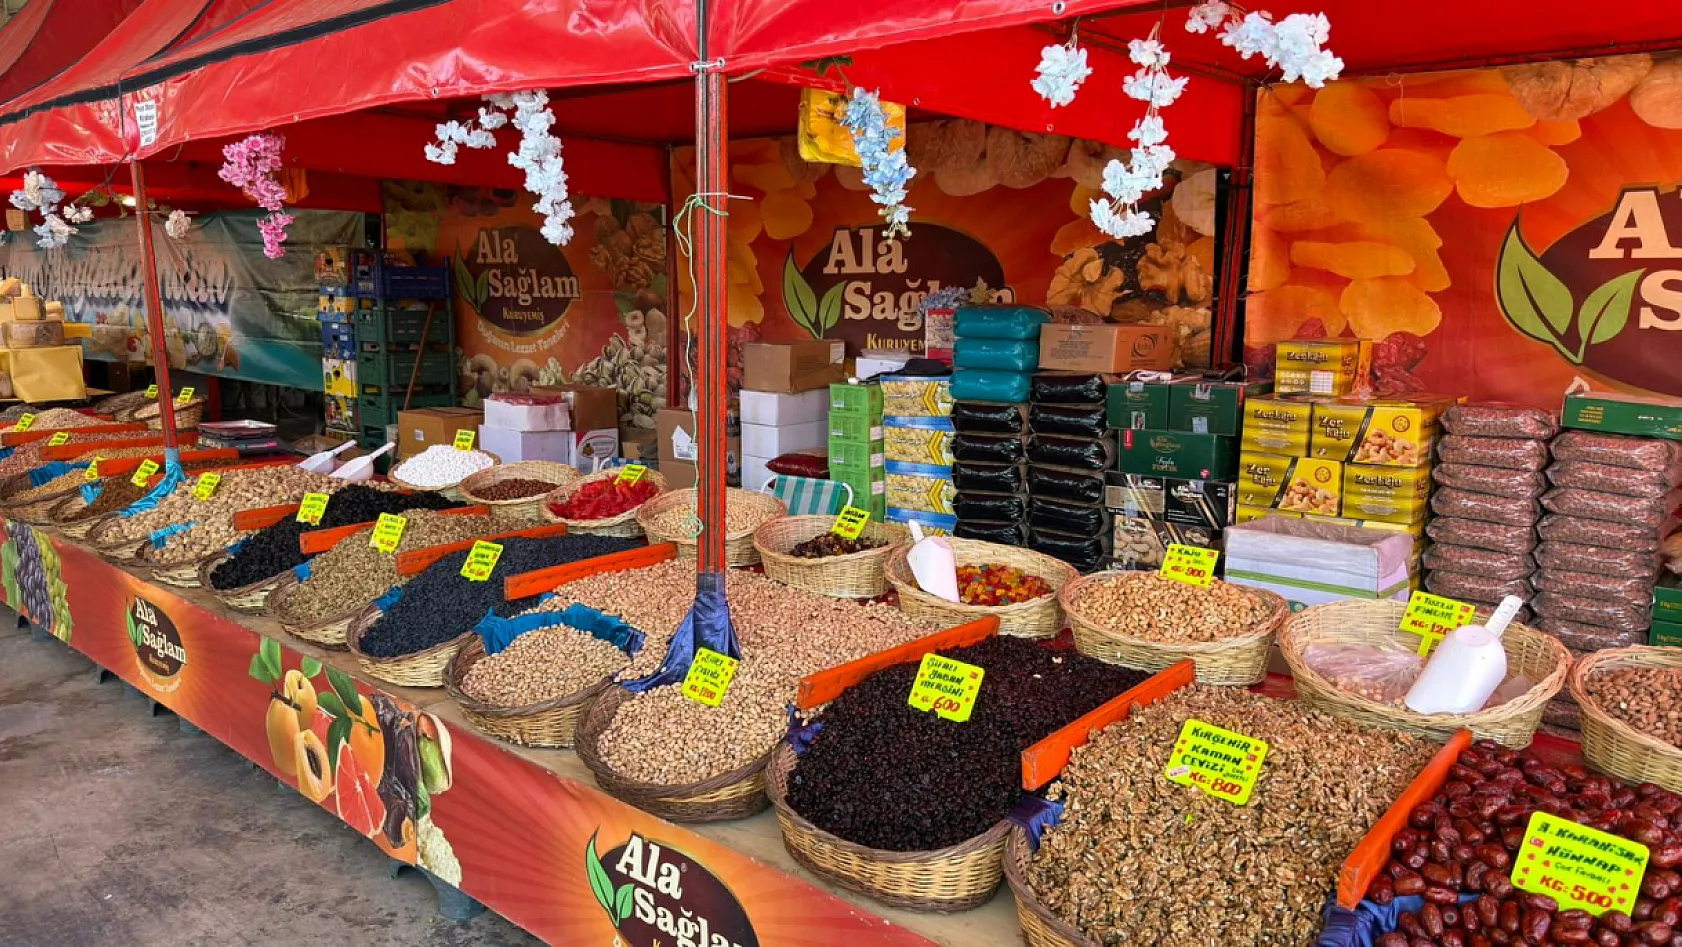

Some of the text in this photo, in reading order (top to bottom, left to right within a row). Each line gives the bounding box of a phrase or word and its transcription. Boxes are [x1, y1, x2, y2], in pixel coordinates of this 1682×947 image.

[476, 229, 519, 264] Ala
[823, 228, 908, 275] Ala
[488, 267, 580, 306] Sağlam
[136, 597, 158, 627] Ala
[143, 624, 187, 664] Sağlam
[933, 696, 960, 712] 600
[1211, 778, 1243, 795] 800
[615, 835, 682, 900] Ala
[1570, 885, 1613, 908] 500
[634, 888, 743, 947] Sağla
